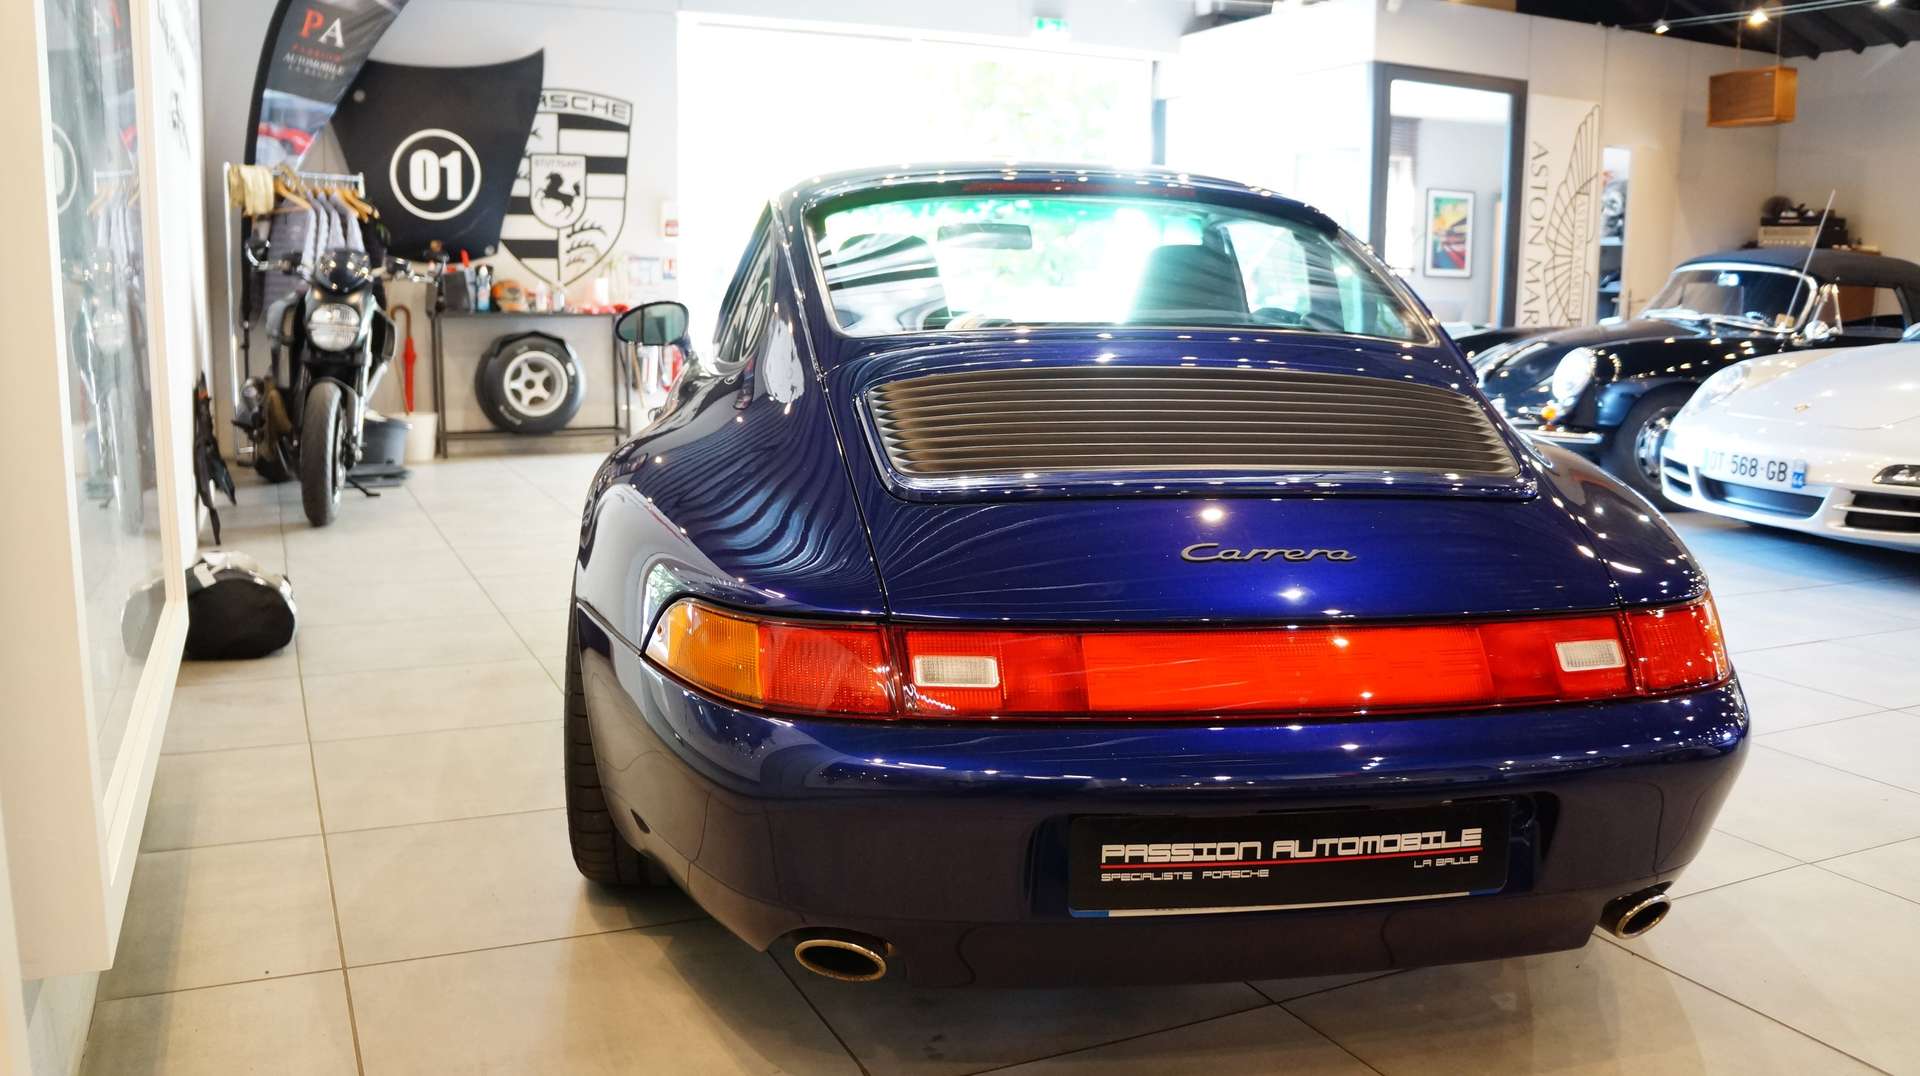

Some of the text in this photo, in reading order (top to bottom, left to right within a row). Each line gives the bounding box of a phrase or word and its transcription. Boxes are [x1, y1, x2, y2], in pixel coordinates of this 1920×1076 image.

[409, 148, 463, 201] 01
[1528, 141, 1549, 246] ASTON
[1180, 542, 1358, 562] Carrera
[1101, 828, 1483, 864] PASSION AUTOMOBILE
[1100, 869, 1270, 882] SPECIALISTE PORSCHE
[1413, 855, 1479, 869] LA BAULE
